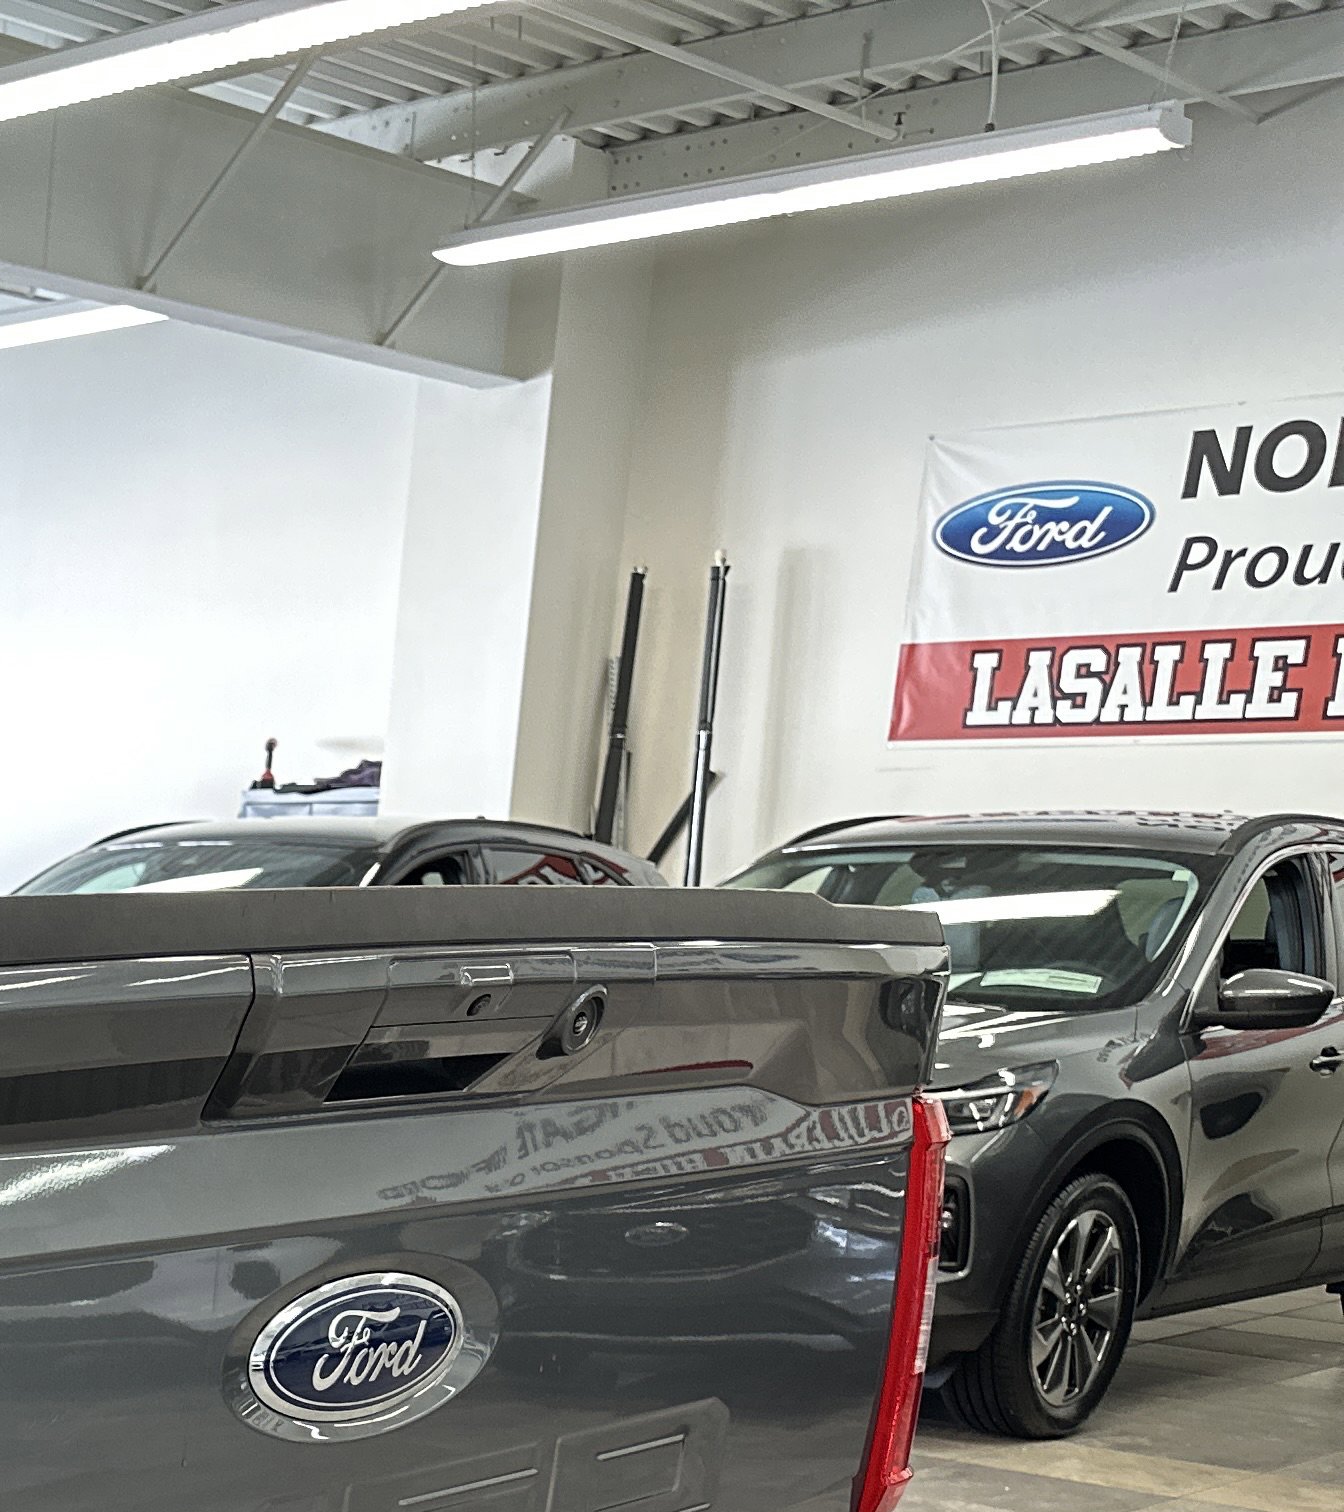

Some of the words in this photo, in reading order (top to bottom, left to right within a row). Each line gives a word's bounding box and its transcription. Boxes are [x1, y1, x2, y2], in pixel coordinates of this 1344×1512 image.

[971, 495, 1112, 556] Ford
[964, 636, 1311, 728] LASALLE
[311, 1306, 424, 1392] Ford
